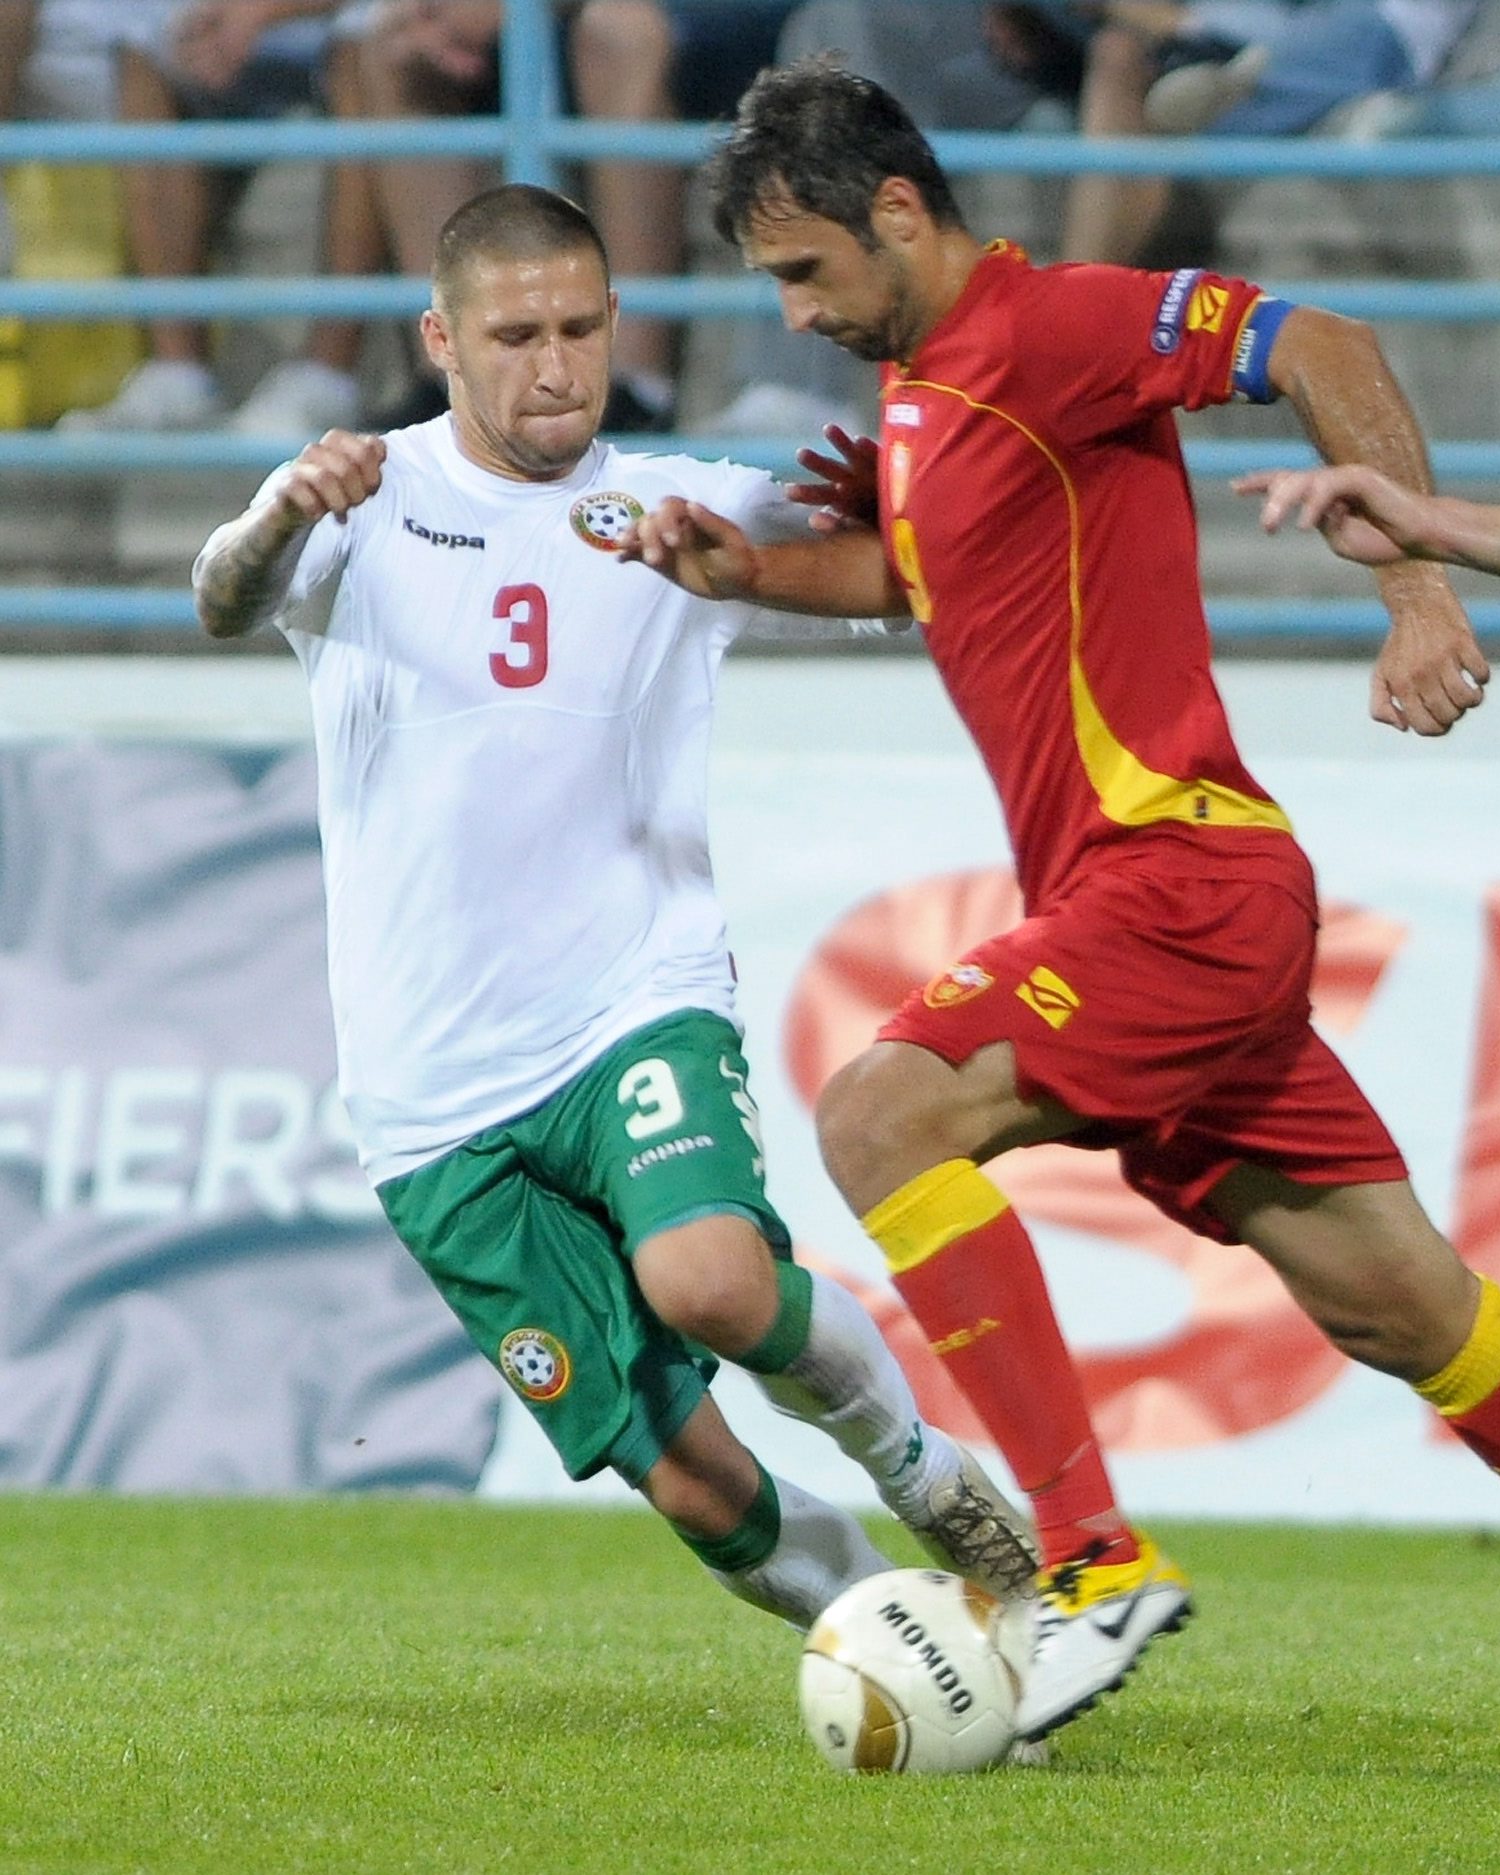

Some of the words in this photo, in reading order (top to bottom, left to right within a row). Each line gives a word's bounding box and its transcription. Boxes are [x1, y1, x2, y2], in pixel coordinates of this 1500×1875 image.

[1158, 268, 1198, 323] RESPEC
[1232, 328, 1257, 374] RACISM
[402, 515, 486, 551] Kappa
[489, 581, 549, 689] 3
[617, 1057, 684, 1141] 3
[877, 1601, 973, 1716] MONDO
